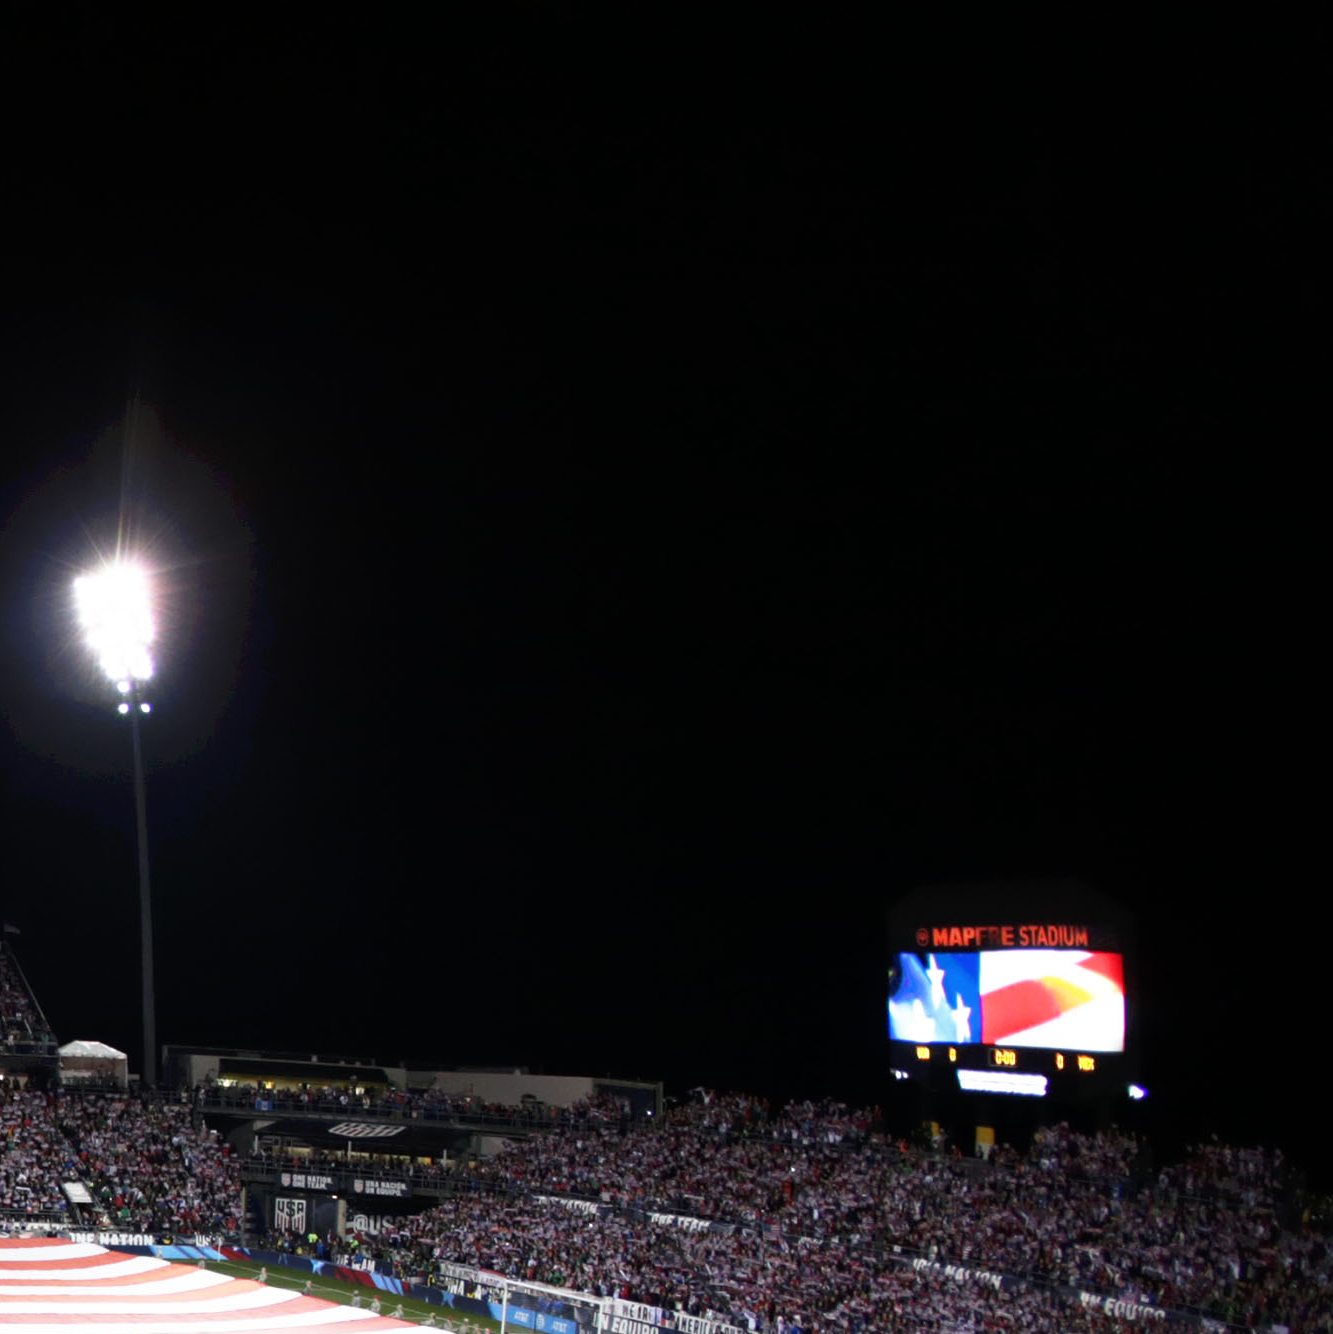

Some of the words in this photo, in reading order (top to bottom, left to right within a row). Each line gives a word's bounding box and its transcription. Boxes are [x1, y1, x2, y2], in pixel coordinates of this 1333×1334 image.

[932, 926, 1014, 946] MAPFRE
[1019, 925, 1088, 946] STADIUM
[292, 1174, 306, 1182] ONE
[100, 1233, 153, 1245] NATION
